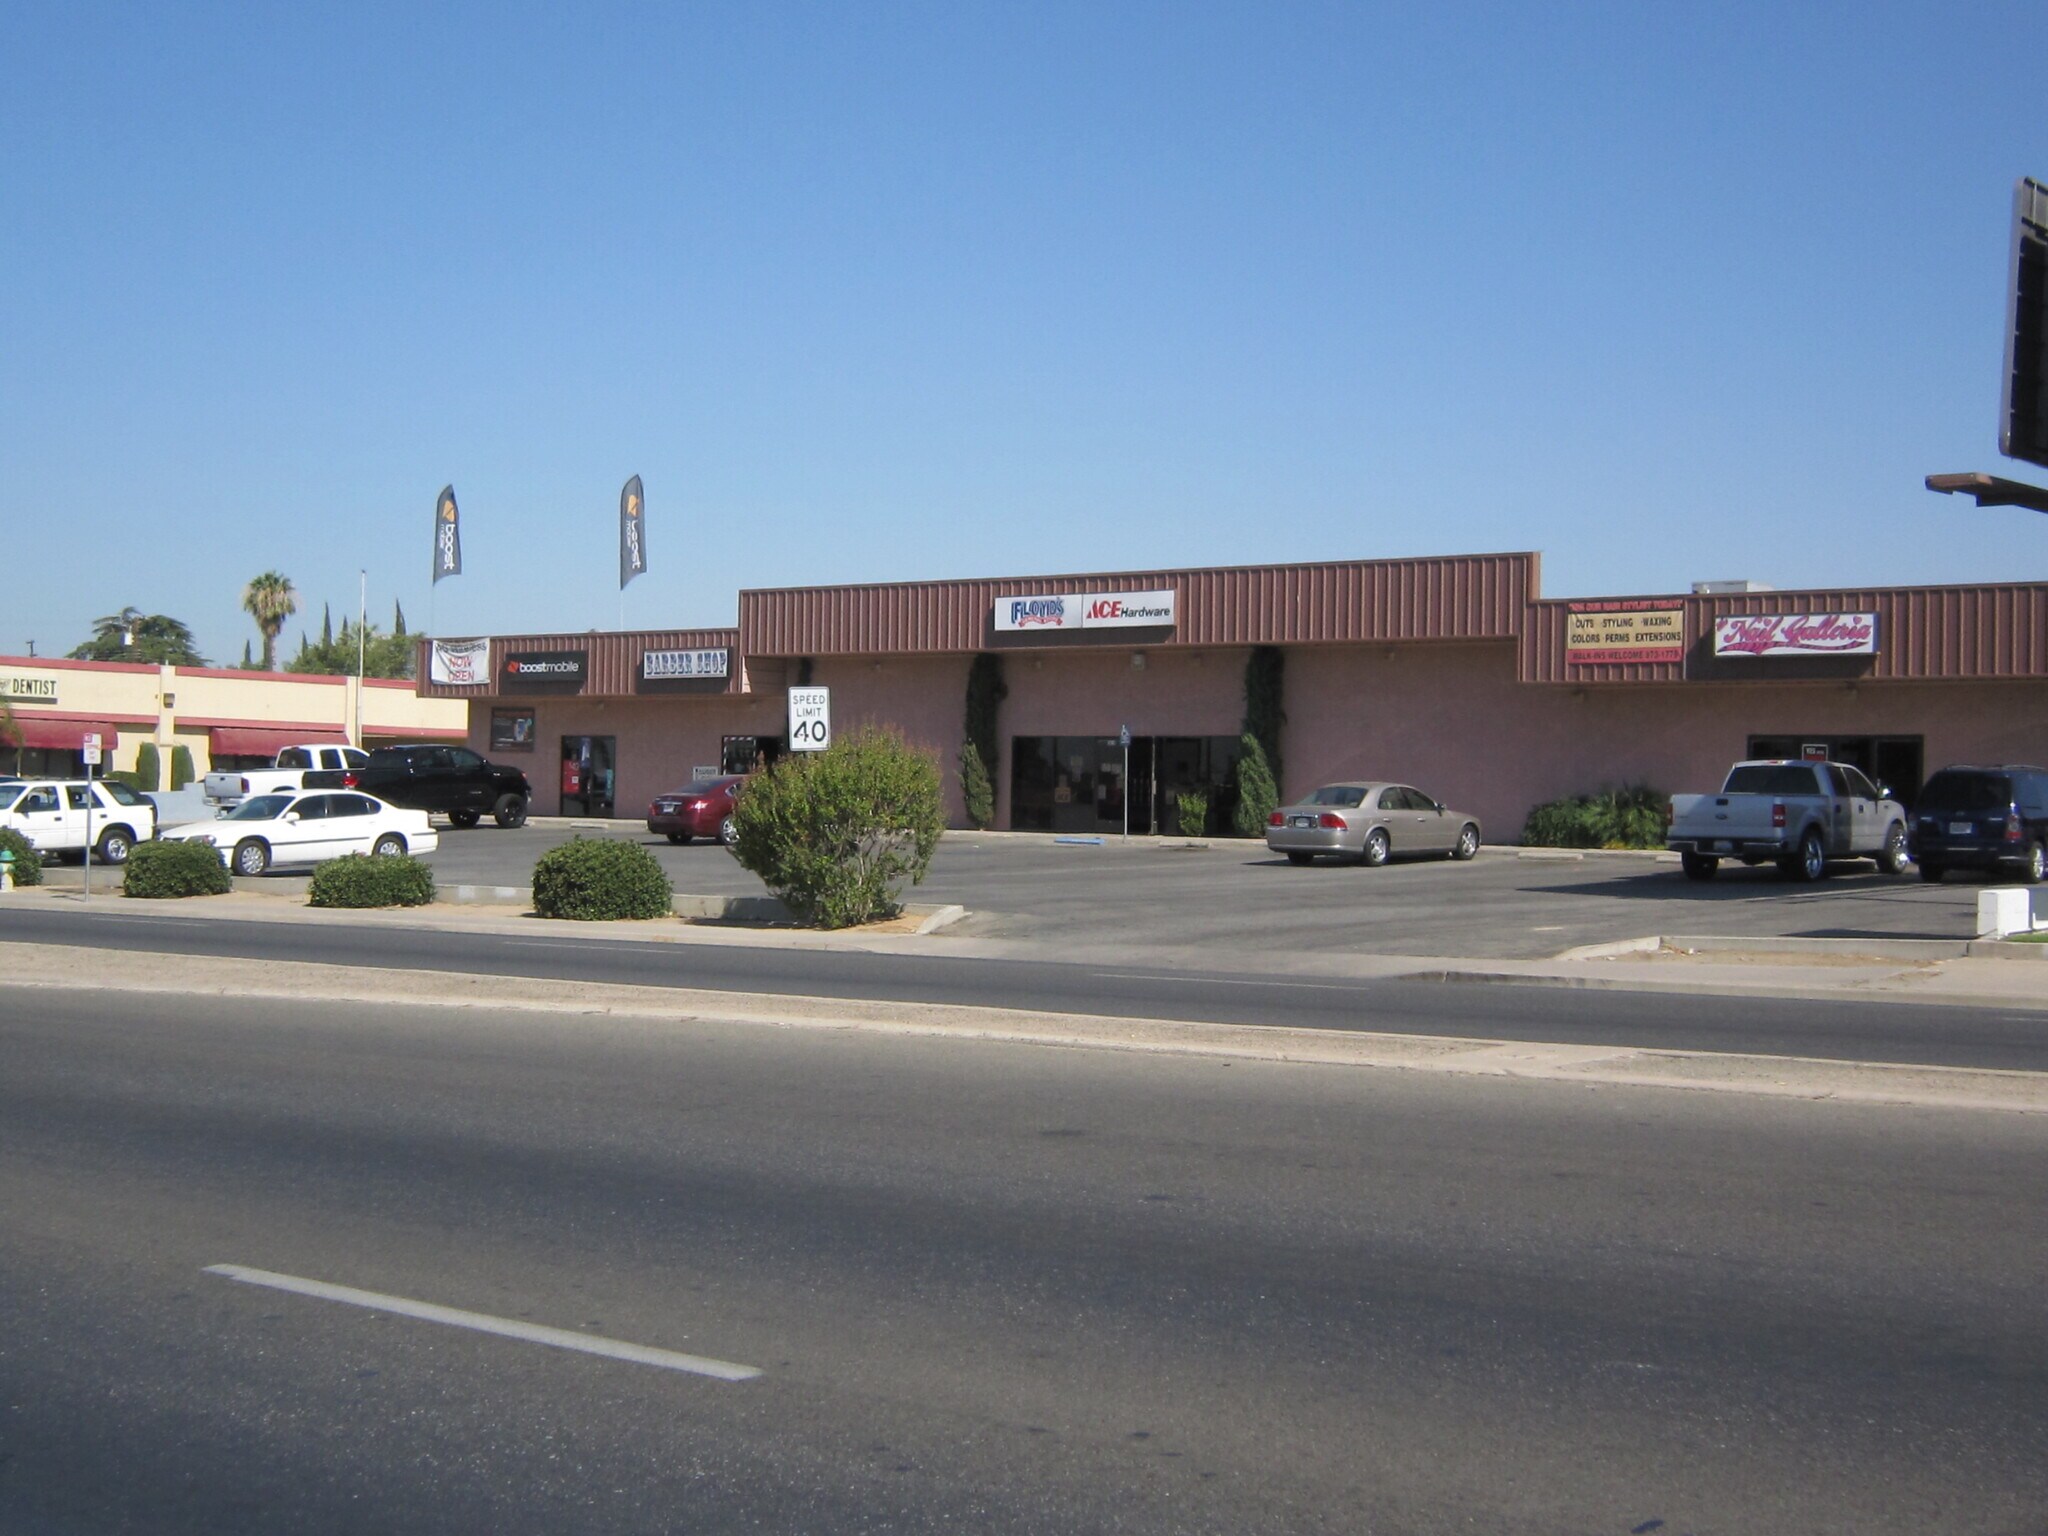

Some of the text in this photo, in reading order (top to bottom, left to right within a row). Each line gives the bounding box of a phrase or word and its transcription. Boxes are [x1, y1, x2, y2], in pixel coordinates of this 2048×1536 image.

[444, 523, 456, 570] boost
[1086, 599, 1171, 619] ACE Hardware
[1575, 618, 1594, 628] CUTS
[1723, 614, 1872, 647] Nail Galleria
[1571, 631, 1681, 643] COLORS PERMS EXTENSIONS
[646, 652, 727, 675] BARBER SHOP
[1608, 651, 1644, 659] WELCOME
[12, 678, 57, 695] DENTIST
[793, 694, 826, 705] SPEED
[796, 707, 822, 717] LIMIT
[793, 720, 826, 742] 40
